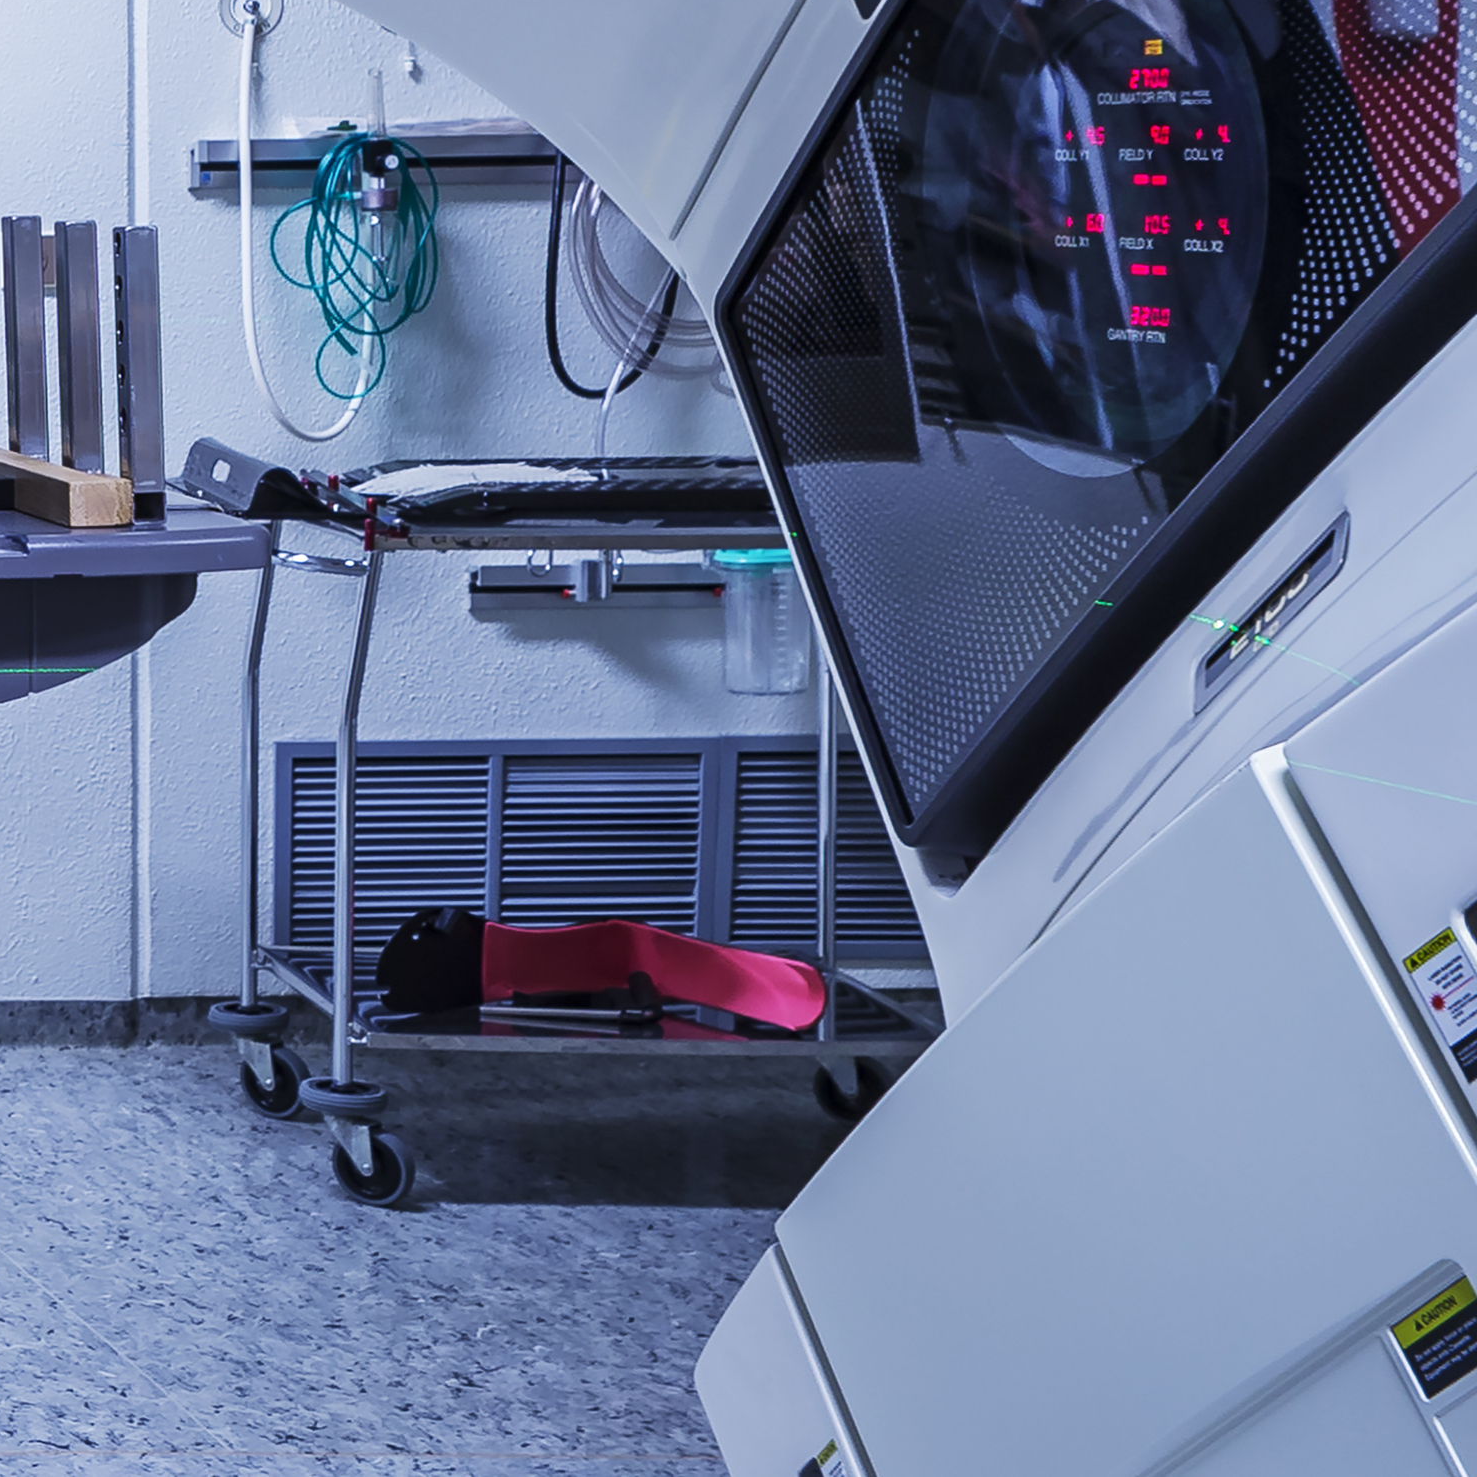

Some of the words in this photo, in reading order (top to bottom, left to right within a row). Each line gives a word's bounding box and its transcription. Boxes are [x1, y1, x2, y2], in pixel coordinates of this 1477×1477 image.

[1211, 148, 1224, 161] Y2
[1107, 328, 1145, 341] GANTRY
[1416, 933, 1452, 962] CAUTION
[1421, 1295, 1458, 1326] CAUTION
